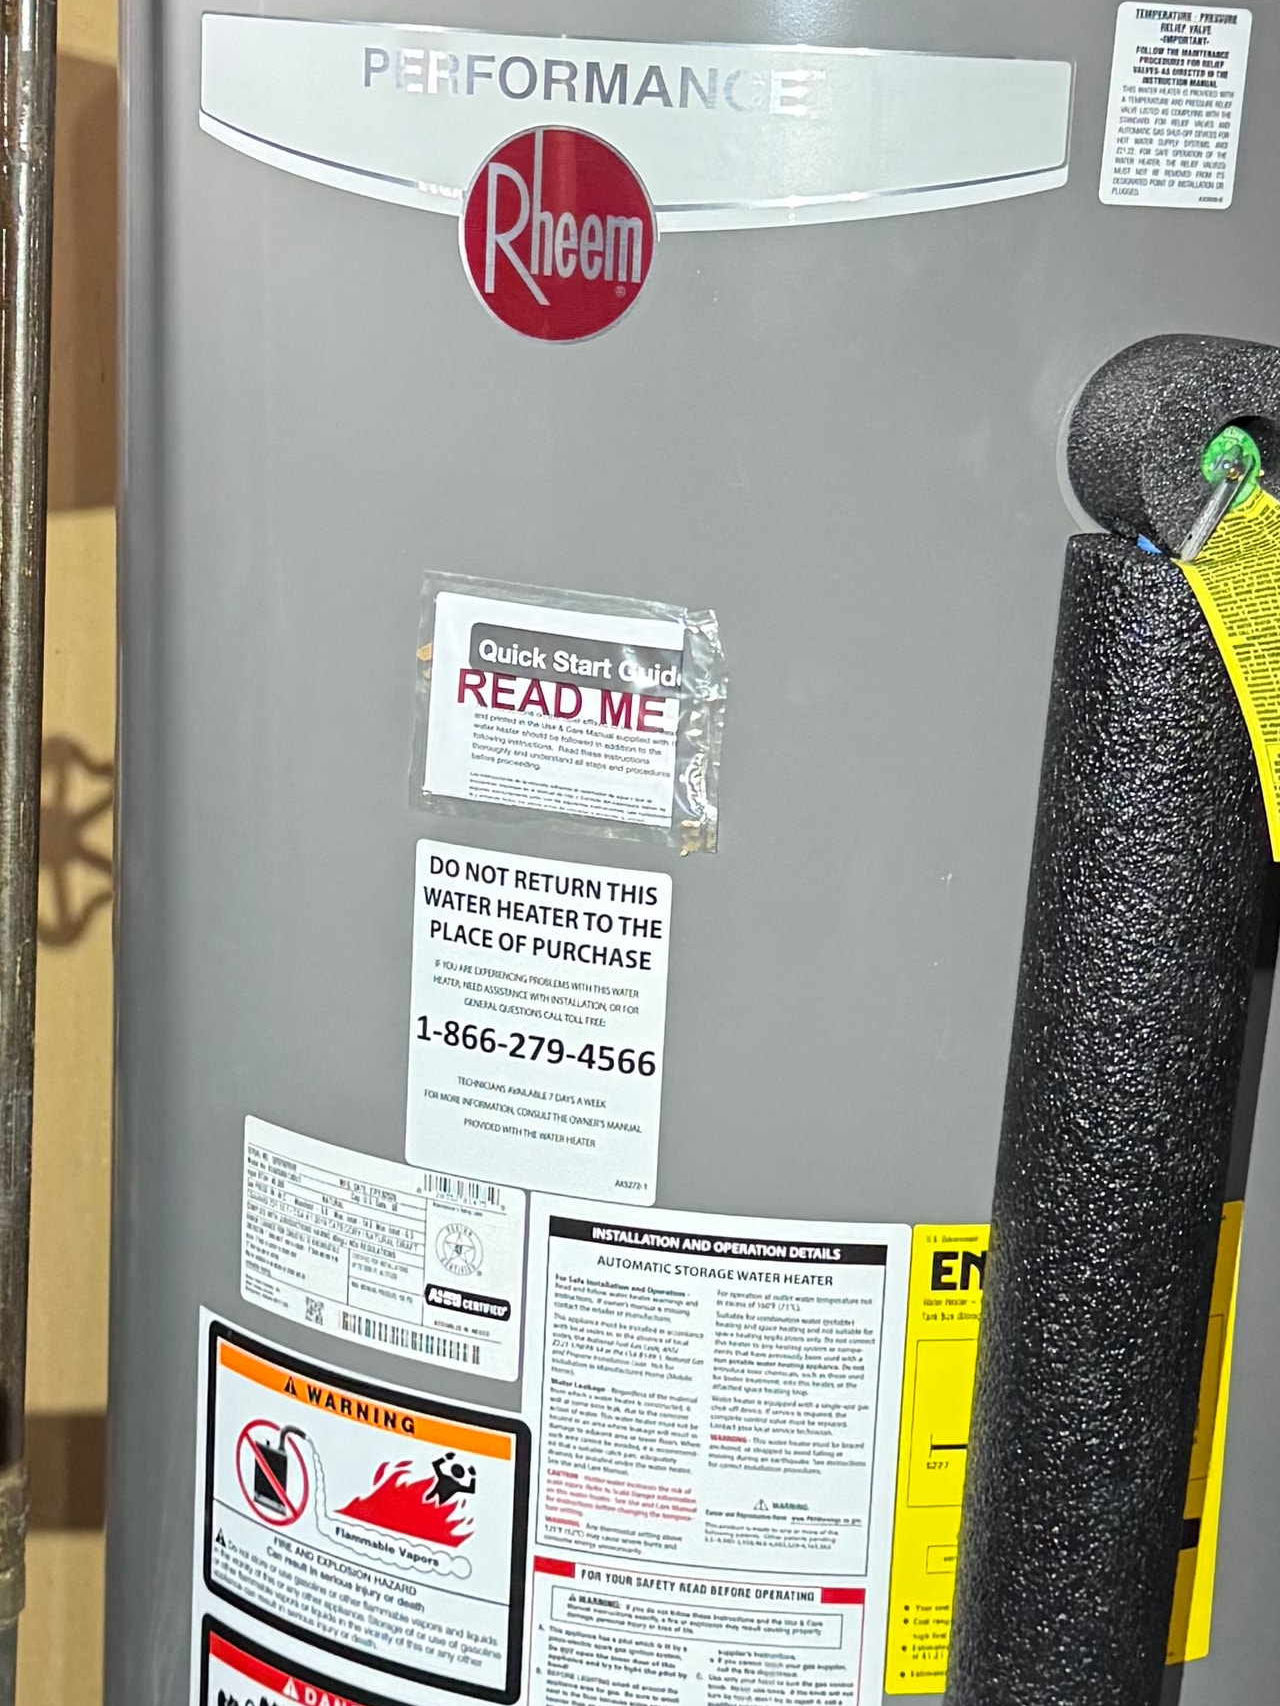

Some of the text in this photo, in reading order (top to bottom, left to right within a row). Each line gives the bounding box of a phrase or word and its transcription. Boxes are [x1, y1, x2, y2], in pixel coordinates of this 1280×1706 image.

[363, 46, 816, 117] PERFORMANCE
[484, 127, 644, 306] Rheem
[479, 639, 547, 669] Quick
[553, 650, 612, 679] Start
[458, 668, 666, 732] READ ME
[430, 855, 657, 906] DO NOT RETURN THIS
[424, 886, 662, 939] WATER HEATER TO THE
[430, 919, 651, 971] PLACE OF PURCHASE
[435, 959, 639, 998] IF YOU ARE EXPERIENCING PROBLEMS WITH THIS WATER
[463, 981, 482, 992] NEED
[484, 983, 527, 1001] ASSISTANCE
[530, 992, 549, 1003] WITH
[610, 1002, 621, 1013] OR
[623, 1004, 639, 1014] FOR
[464, 997, 497, 1011] GENERAL
[499, 1003, 542, 1018] QUESTIONS
[544, 1010, 562, 1022] CALL
[564, 1013, 583, 1024] TOLL
[417, 1015, 656, 1077] 1-866-279-4566
[424, 1089, 439, 1100] FOR
[440, 1093, 460, 1104] MORE
[517, 1107, 552, 1120] CONSULT
[553, 1113, 567, 1124] THE
[607, 1122, 642, 1133] MANUAL
[457, 1076, 506, 1093] TECHNICIANS
[508, 1085, 547, 1100] AVAILABLE
[555, 1093, 575, 1105] DAYS
[577, 1096, 583, 1104] A
[584, 1098, 606, 1108] WEEK
[464, 1118, 595, 1148] PROVIDED WITH THE WATER HEATER
[593, 1227, 841, 1260] INSTALLATION AND OPERATION DETAILS
[597, 1255, 833, 1287] AUTOMATIC STORAGE WATER HEATER
[307, 1383, 415, 1435] WARNING
[274, 1536, 417, 1597] FIRE AND EXPLOSION HAZARD
[335, 1526, 440, 1567] Flammable Vapors
[581, 1569, 814, 1602] FOR YOUR SAFETY READ BEFORE OPERATING
